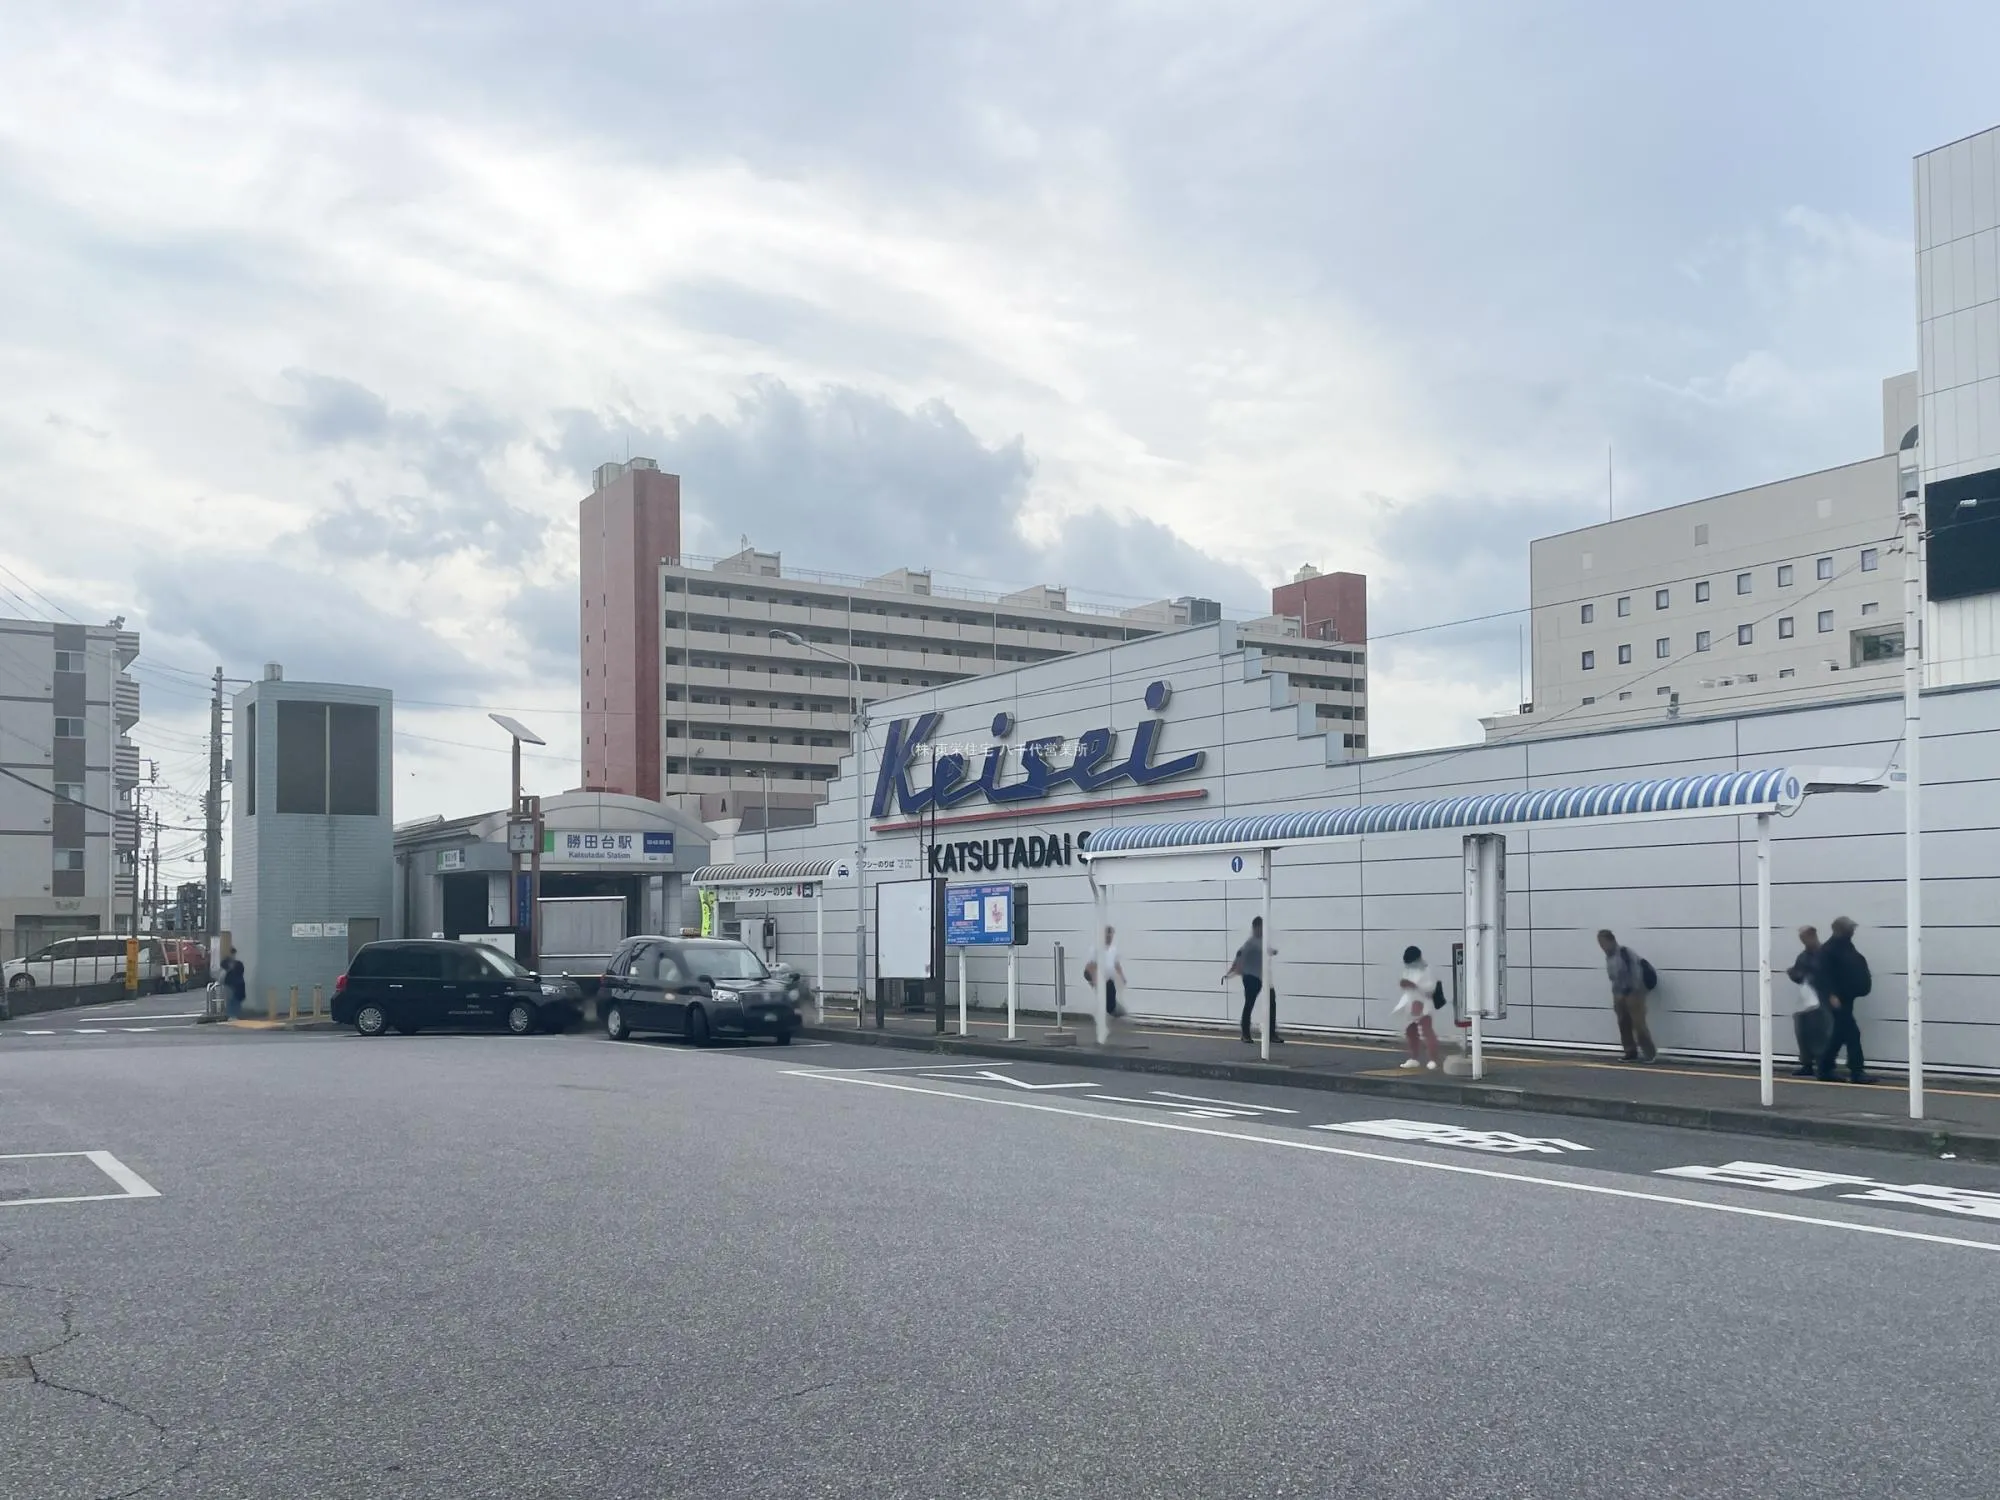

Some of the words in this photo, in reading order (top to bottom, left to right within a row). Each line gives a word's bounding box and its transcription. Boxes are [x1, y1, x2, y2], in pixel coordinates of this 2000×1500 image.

[870, 680, 1206, 818] Keisei
[567, 834, 632, 849] 勝田台駅
[607, 851, 631, 859] Station
[928, 832, 1072, 874] KATSUTADAI
[856, 860, 895, 869] クシーのりば
[748, 886, 793, 898] タクシーのりば
